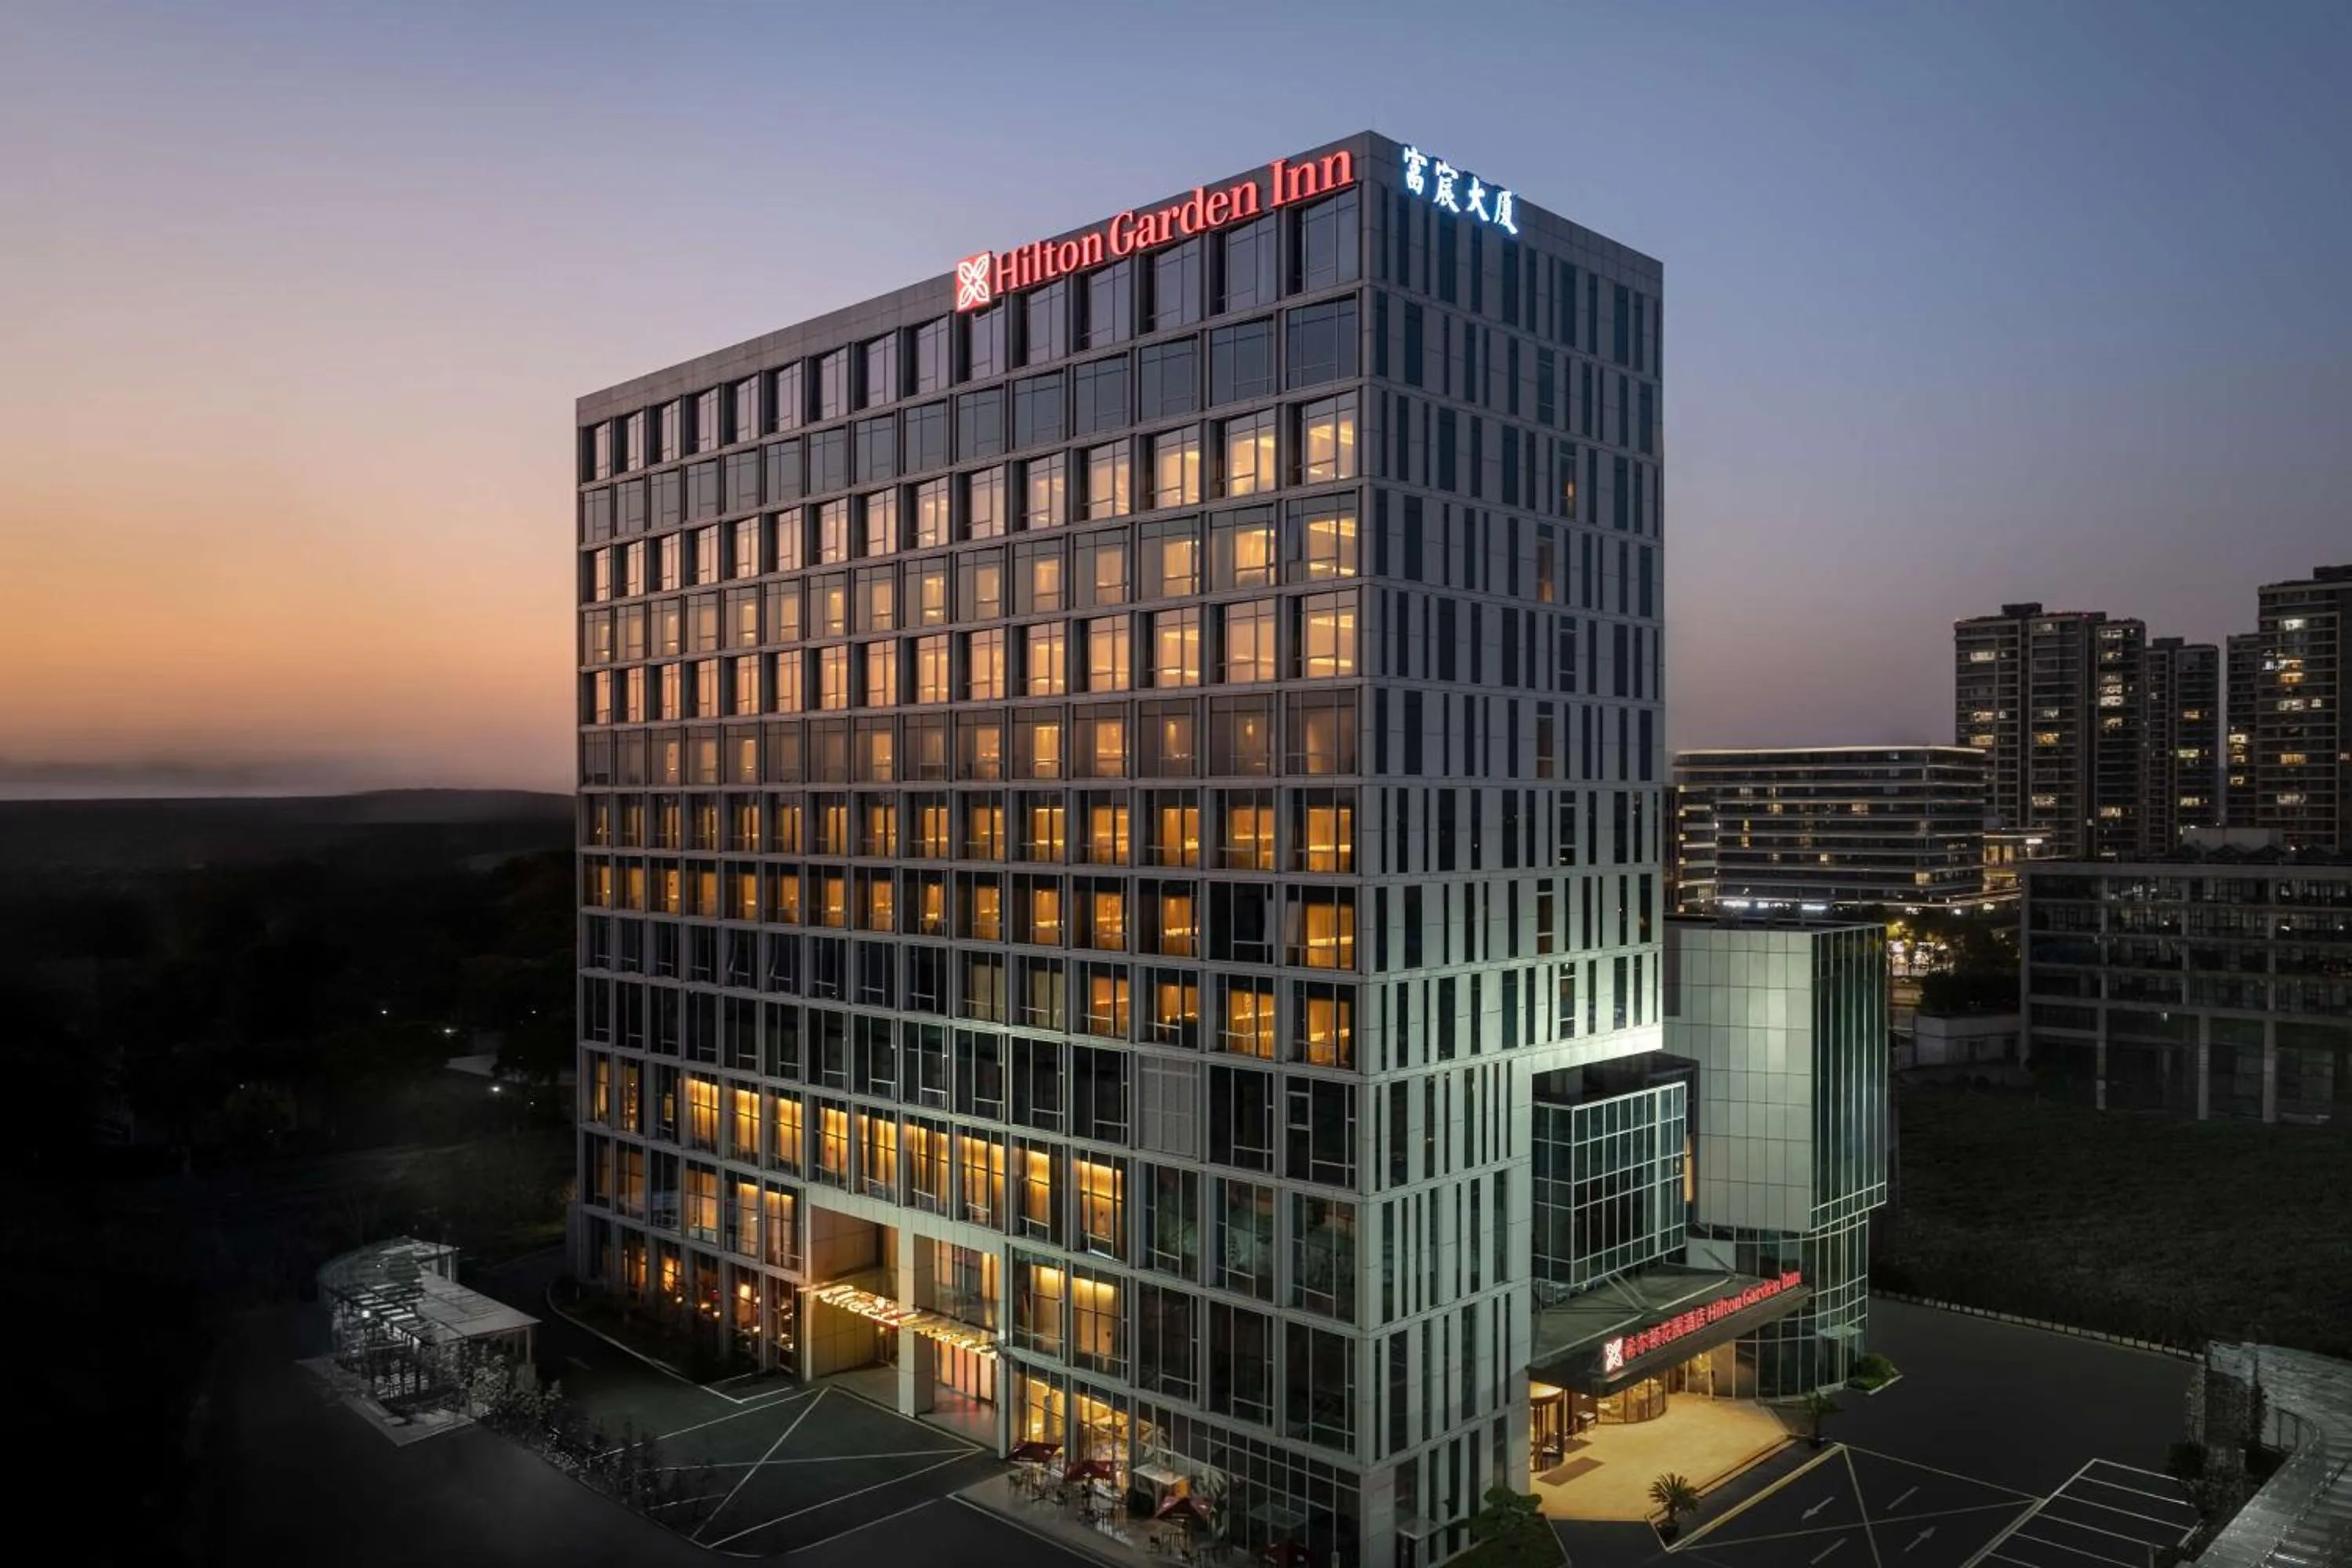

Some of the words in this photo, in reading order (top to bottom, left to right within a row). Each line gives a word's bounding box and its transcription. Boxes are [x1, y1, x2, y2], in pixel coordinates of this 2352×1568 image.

[994, 232, 1103, 294] Hilton
[1109, 180, 1259, 256] Garden
[1269, 150, 1354, 208] Inn
[1707, 1298, 1742, 1323] Hilton
[1742, 1279, 1780, 1305] Garden
[1781, 1271, 1802, 1290] Inn
